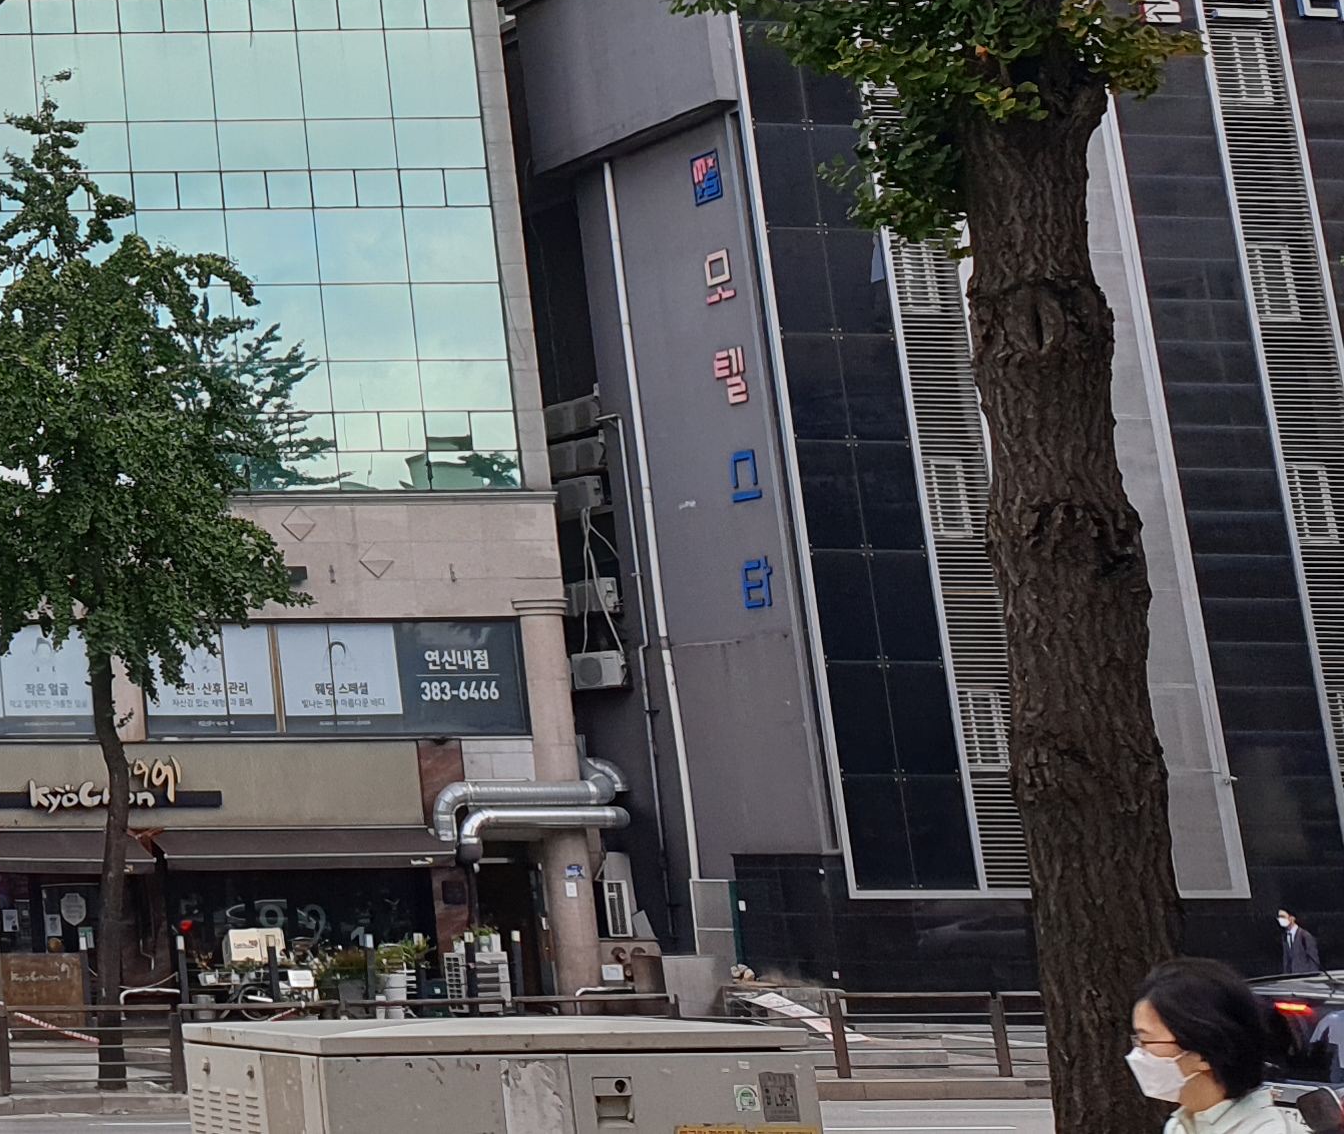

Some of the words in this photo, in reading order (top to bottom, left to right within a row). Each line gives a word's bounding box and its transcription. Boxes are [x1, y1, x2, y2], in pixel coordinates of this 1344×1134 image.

[424, 649, 490, 671] 연신내점
[228, 681, 249, 695] 관리
[420, 681, 500, 701] 383-6466
